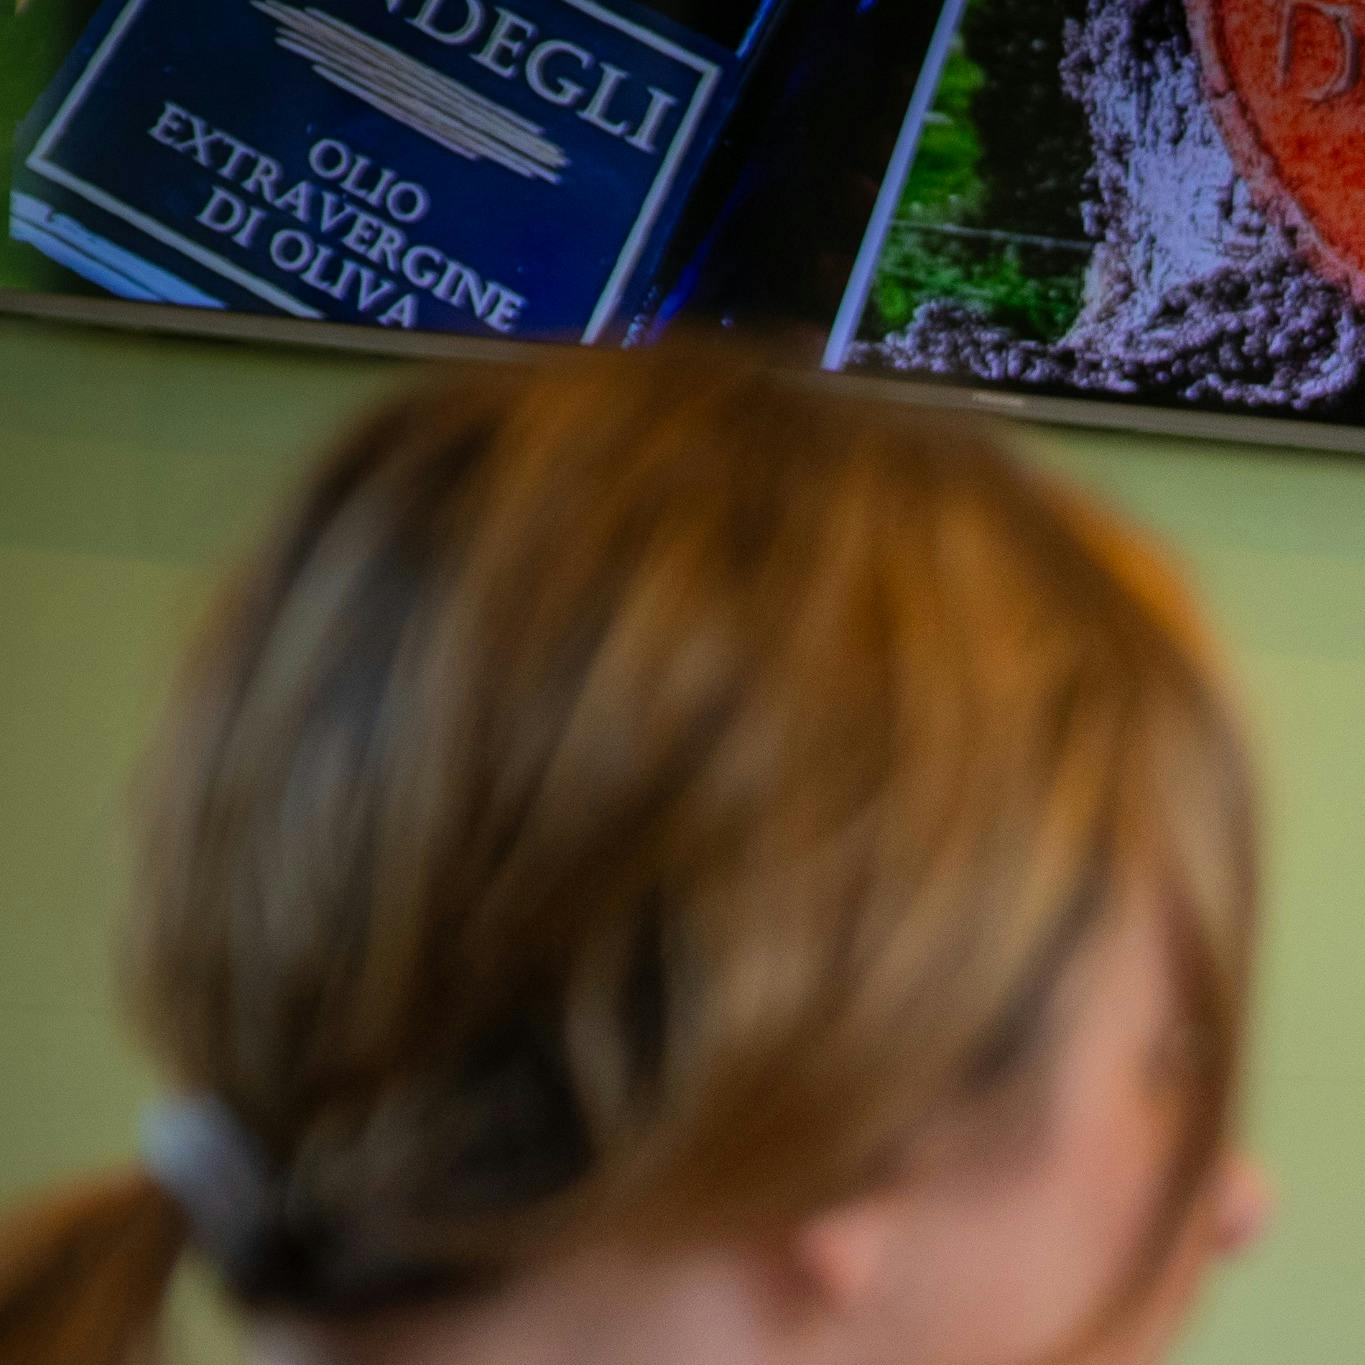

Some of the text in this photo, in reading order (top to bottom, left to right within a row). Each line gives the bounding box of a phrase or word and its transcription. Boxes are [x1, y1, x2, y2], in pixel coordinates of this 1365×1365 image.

[385, 0, 677, 154] DEGLI
[147, 101, 527, 333] EXTRAVERGINE
[309, 138, 430, 223] OLIO
[195, 186, 419, 328] DI OLIVA
